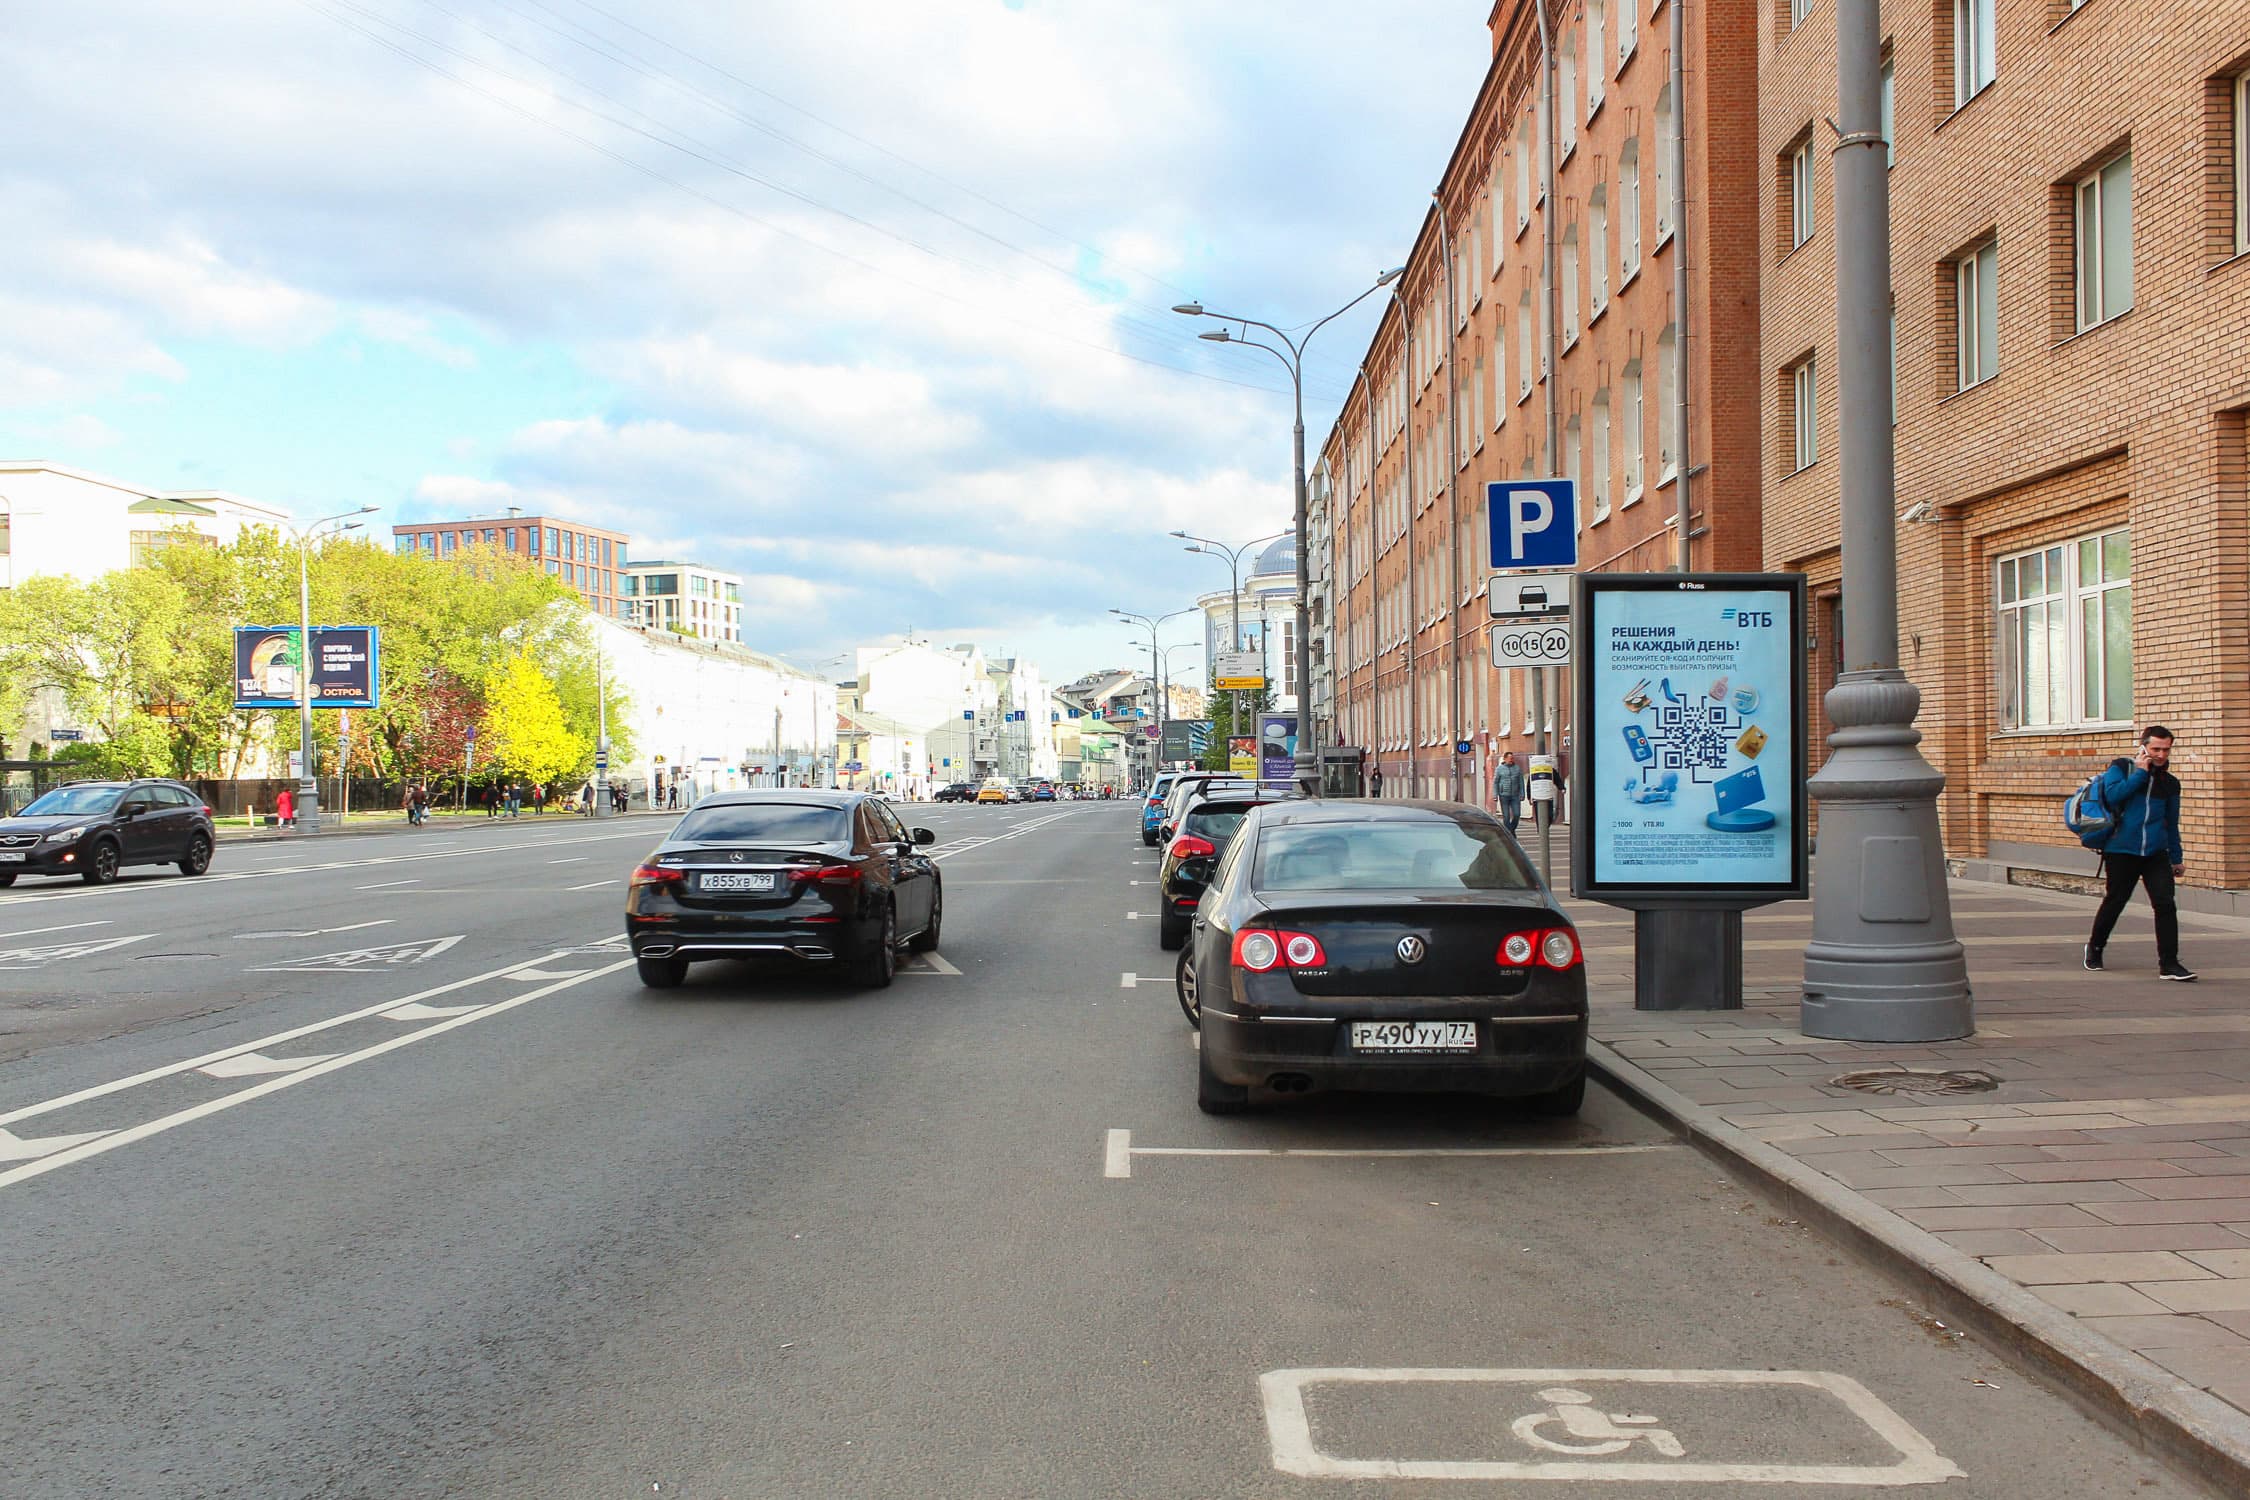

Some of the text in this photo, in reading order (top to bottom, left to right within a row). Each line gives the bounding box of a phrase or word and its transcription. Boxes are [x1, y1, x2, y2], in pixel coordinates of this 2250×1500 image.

[1508, 490, 1554, 560] P
[1687, 582, 1705, 590] Russ
[1738, 612, 1772, 628] ВТБ
[1611, 627, 1676, 637] РЕШЕНИЯ
[1505, 637, 1566, 652] 10 15 20
[1611, 638, 1740, 652] НА КАЖДЫЙ ДЕНЬ!
[1611, 654, 1659, 662] СКАНИРУЙТЕ
[1448, 1024, 1469, 1039] 77
